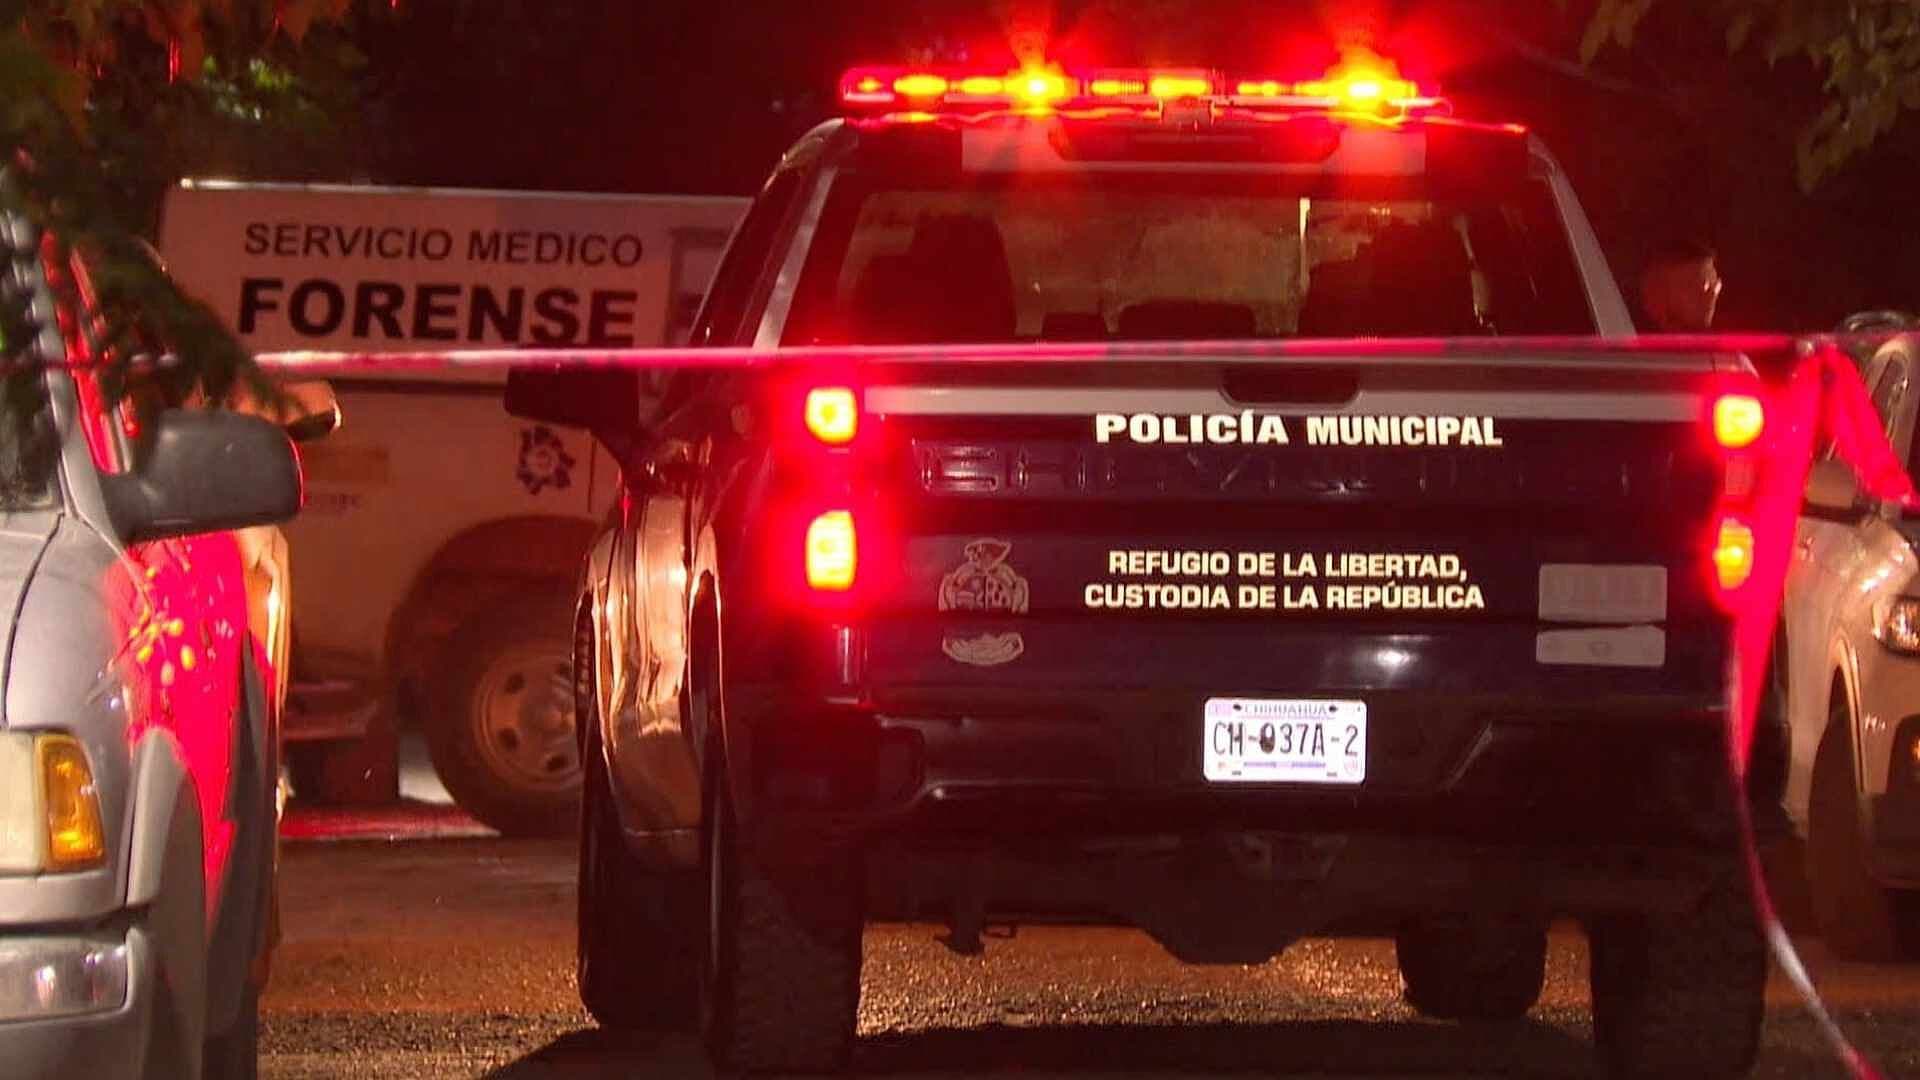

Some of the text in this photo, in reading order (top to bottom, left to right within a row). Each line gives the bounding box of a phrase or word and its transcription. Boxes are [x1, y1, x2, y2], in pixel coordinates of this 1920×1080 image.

[244, 222, 643, 267] SERVICIO MEDICO
[237, 277, 639, 347] FORENSE
[1096, 409, 1503, 446] POLICÍA MUNICIPAL
[1109, 550, 1467, 582] REFUGIO DE LA LIBERTAD,
[1084, 580, 1485, 609] CUSTODIA DE LA REPÚBLICA
